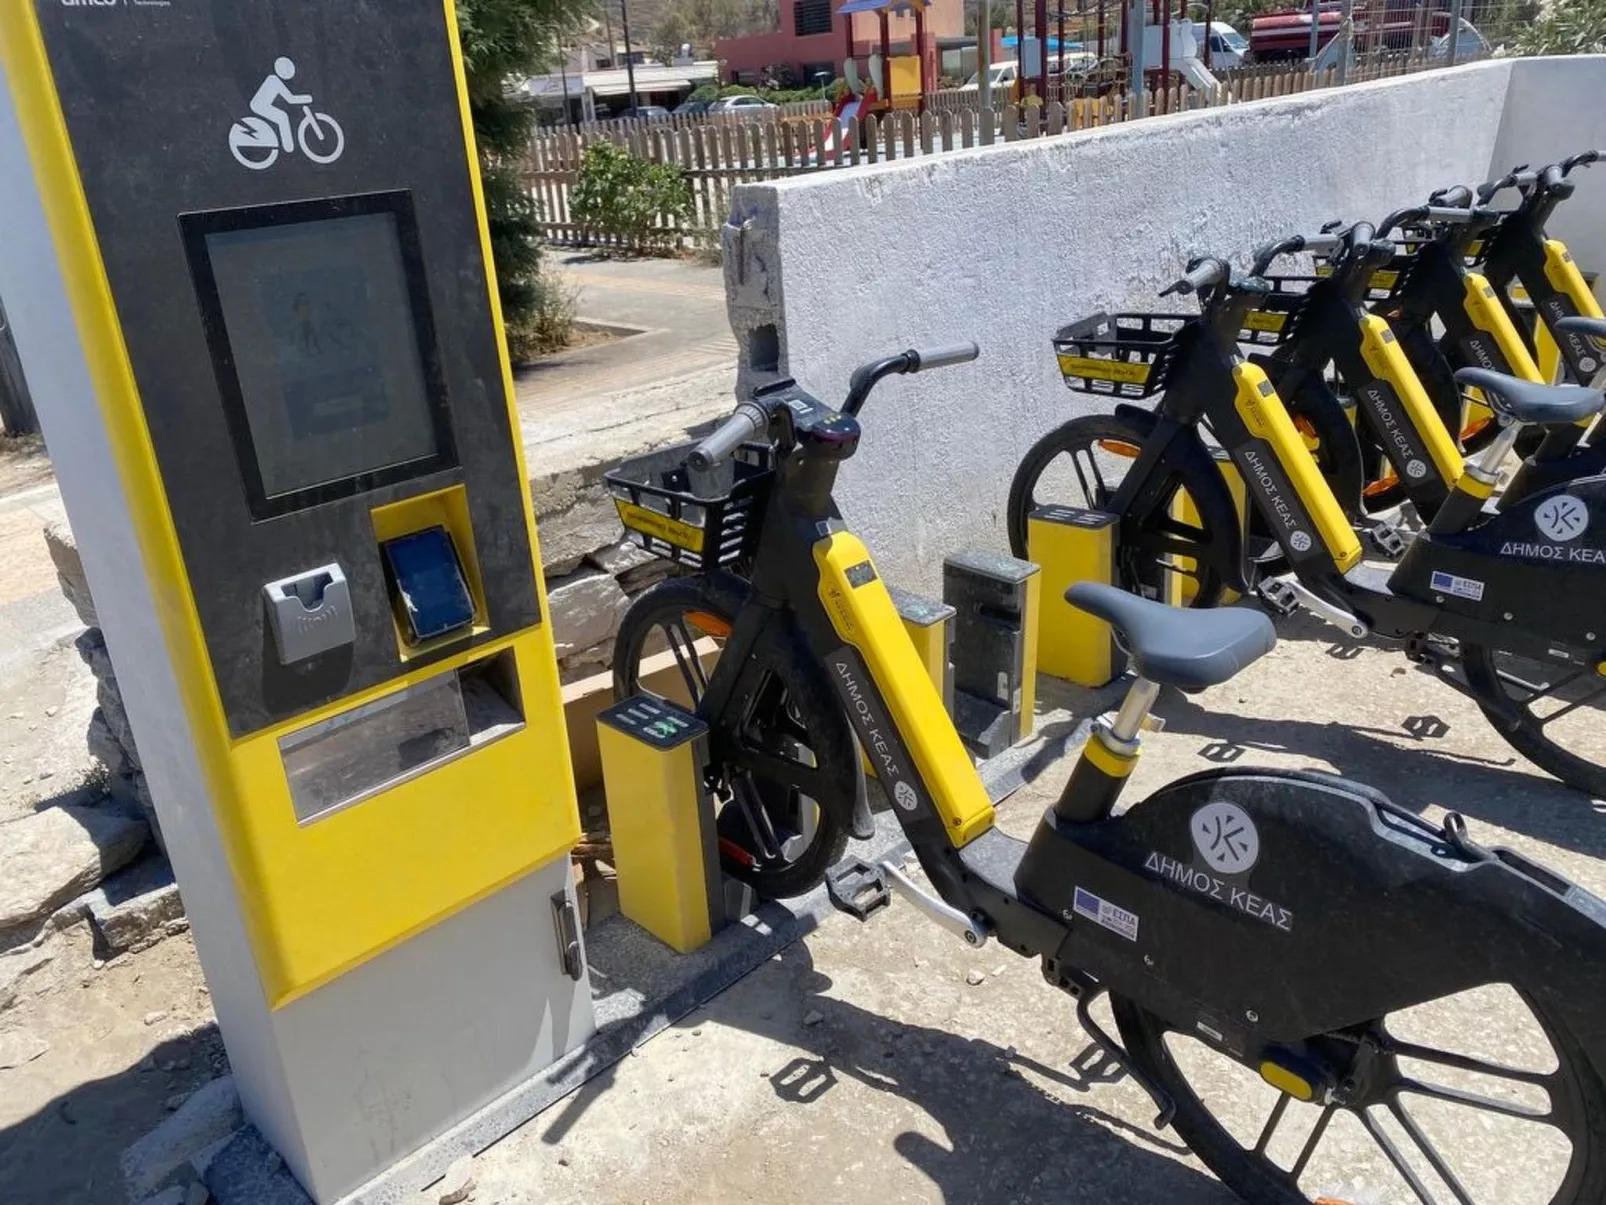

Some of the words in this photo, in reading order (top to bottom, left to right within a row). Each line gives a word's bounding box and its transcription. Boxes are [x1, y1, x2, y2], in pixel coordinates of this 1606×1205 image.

[1470, 340, 1496, 371] ΔΗΜΟ
[1367, 389, 1396, 429] ΔΗΜΟΣ
[1390, 428, 1414, 459] ΚΕΑΣ
[1244, 451, 1278, 495] ΔΗΜΟΣ
[1271, 495, 1298, 529] ΚΕΑΣ
[1500, 542, 1564, 560] ΔΗΜΟΣ
[1569, 547, 1606, 564] ΚΕΑ
[836, 662, 874, 726] ΔΗΜΟΣ
[869, 728, 900, 777] ΚΕΑΣ
[1144, 852, 1225, 900] ΔΗΜΟΣ
[1230, 887, 1293, 932] ΚΕΑΣ
